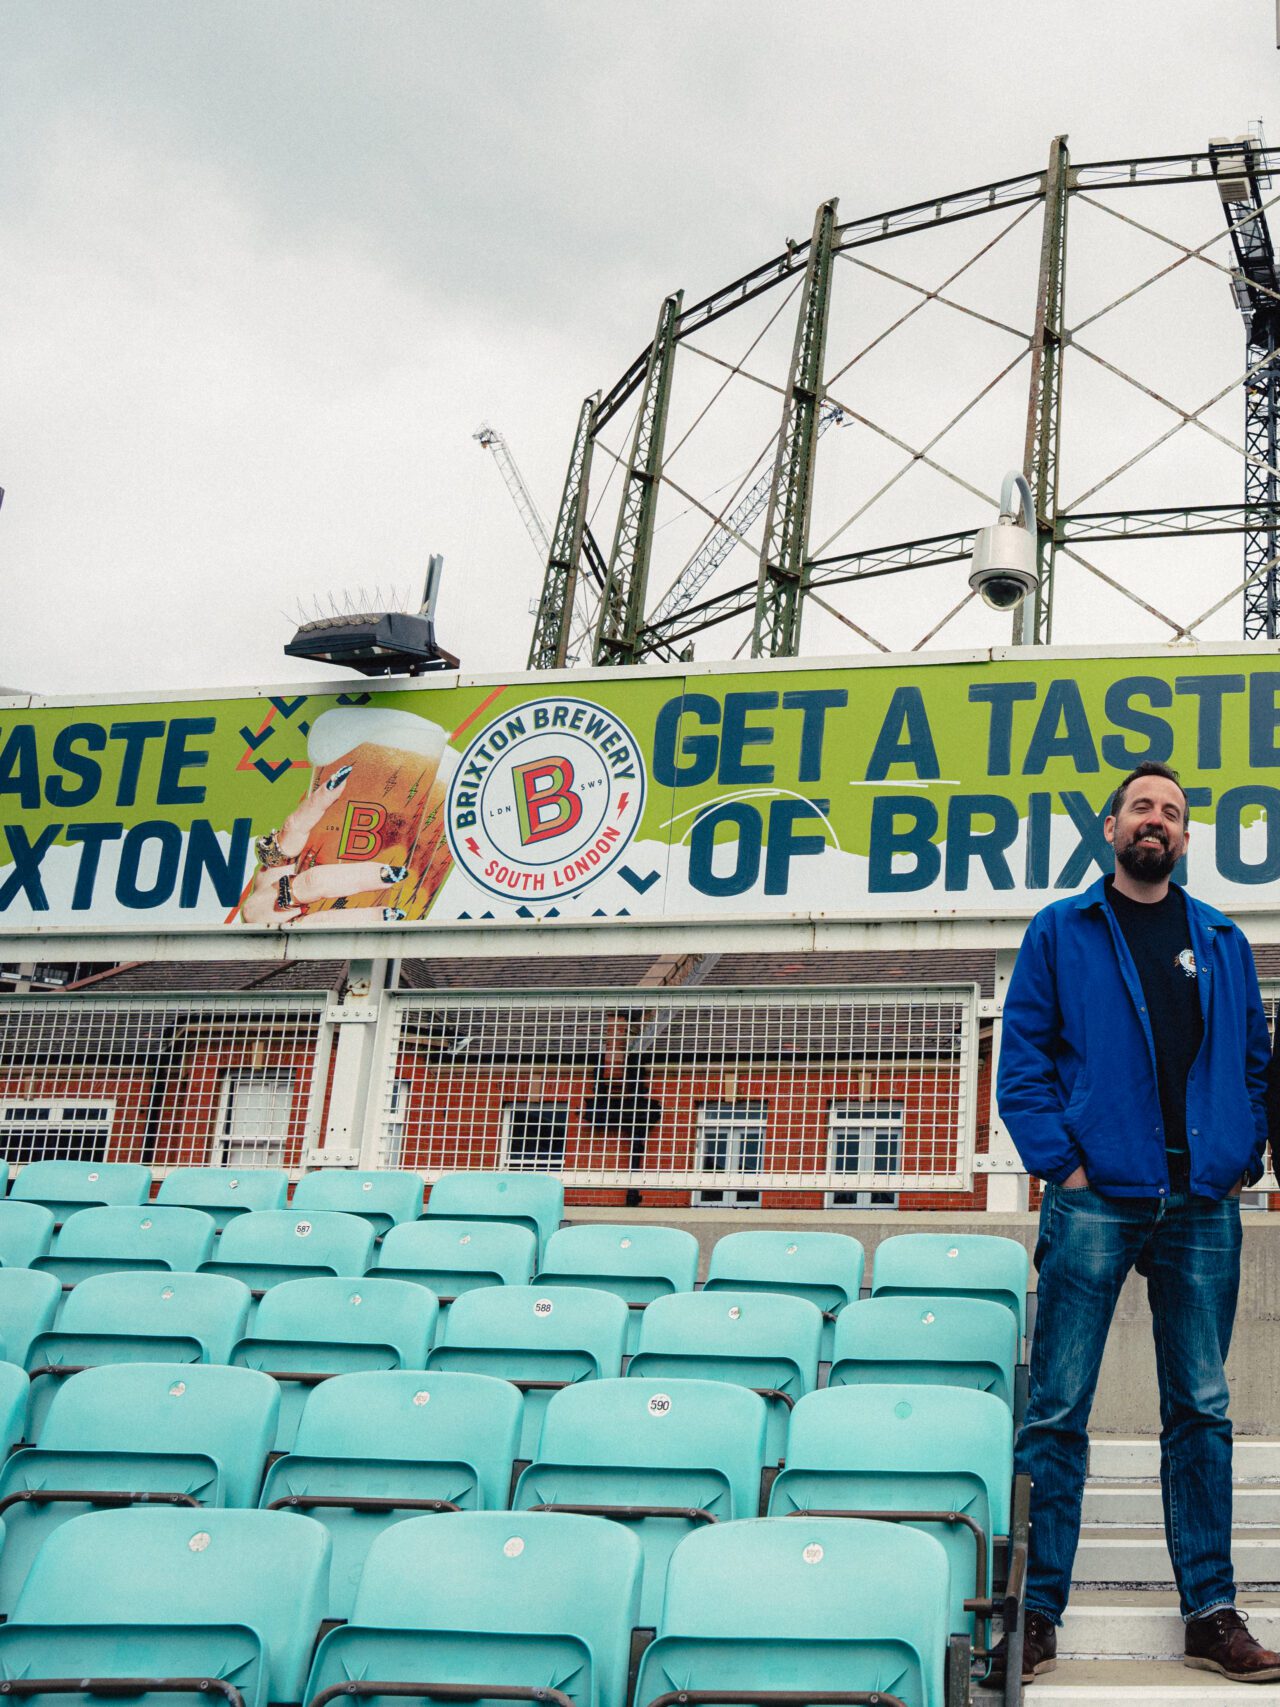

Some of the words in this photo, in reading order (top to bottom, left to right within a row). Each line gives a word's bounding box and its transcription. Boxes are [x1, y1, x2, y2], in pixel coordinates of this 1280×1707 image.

[0, 717, 217, 809] ASTE
[456, 715, 526, 829] BRIXTON
[534, 705, 636, 780] BREWERY
[652, 688, 848, 788] GET
[863, 686, 941, 781] A
[337, 800, 387, 861] B
[489, 805, 511, 817] LDN
[580, 779, 603, 791] SW9
[511, 755, 583, 847] B
[484, 859, 545, 891] SOUTH
[553, 825, 621, 887] LONDON
[688, 799, 831, 897] OF
[296, 1225, 311, 1233] 587
[535, 1303, 552, 1312] 588
[650, 1399, 670, 1411] 590
